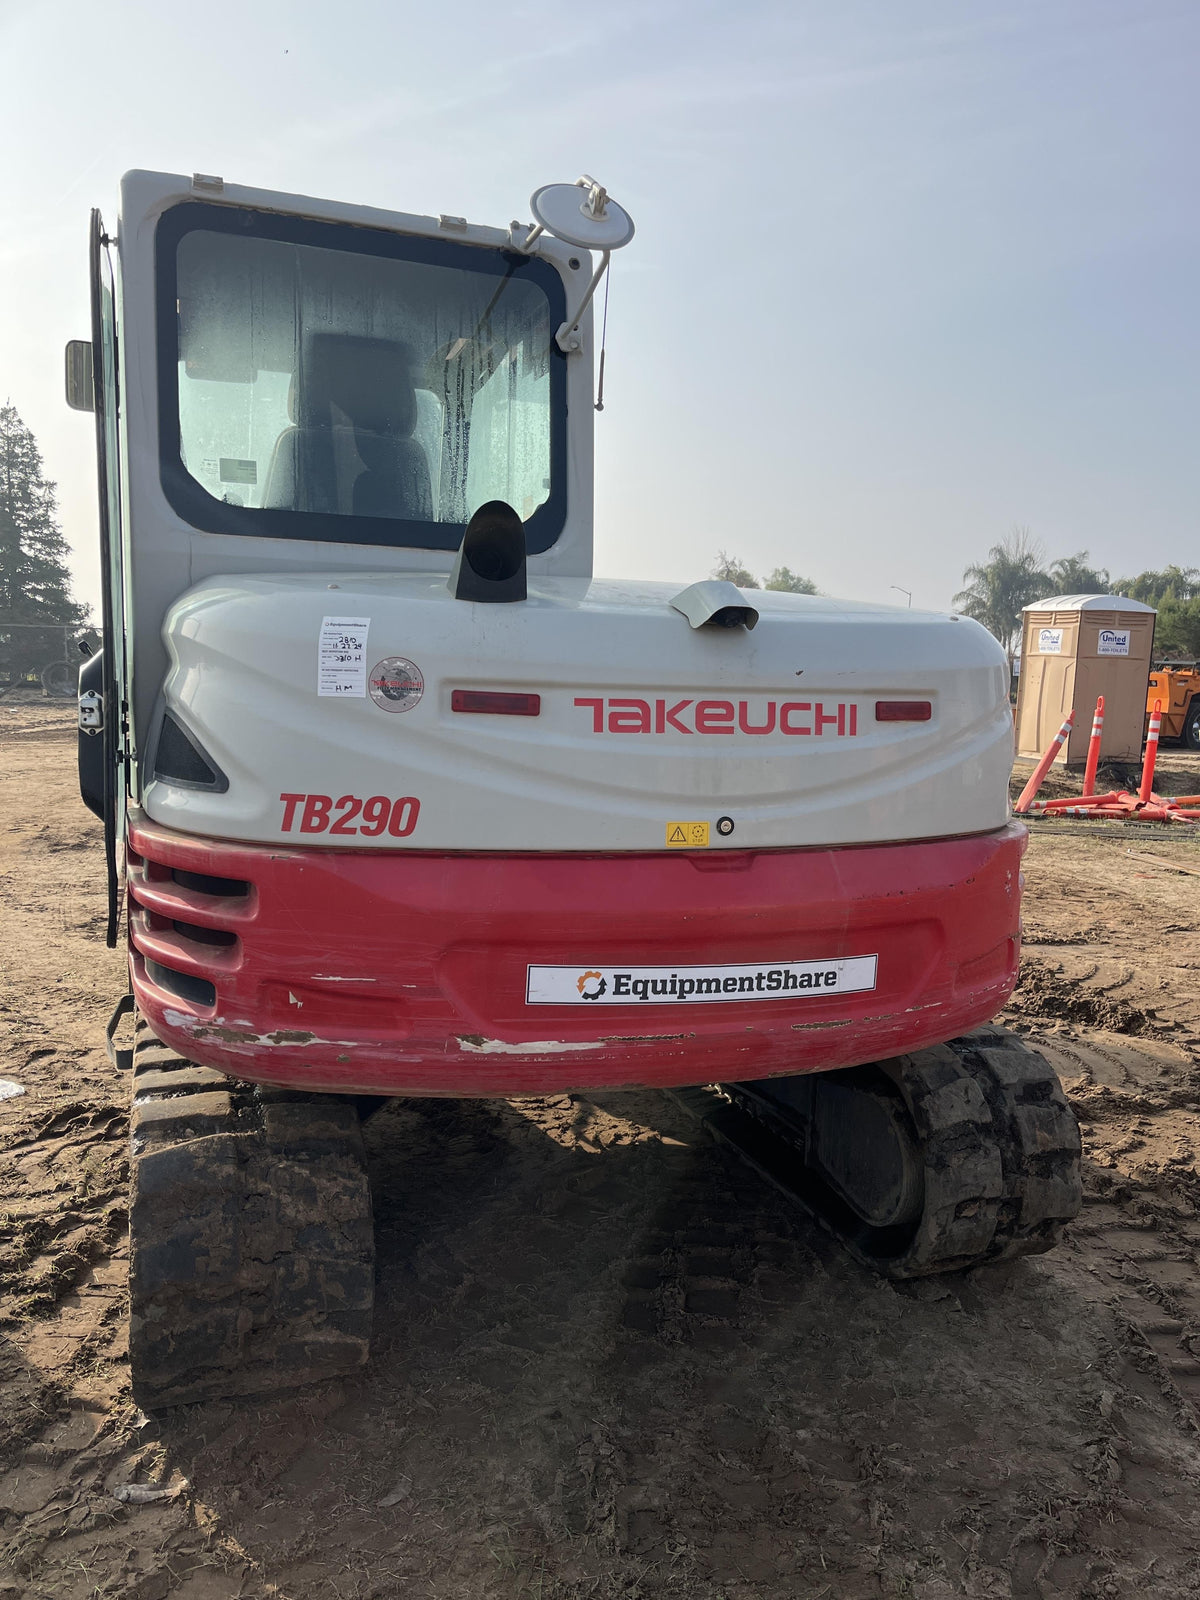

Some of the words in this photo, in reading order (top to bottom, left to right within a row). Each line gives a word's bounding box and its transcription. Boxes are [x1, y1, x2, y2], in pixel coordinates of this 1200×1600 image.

[1102, 634, 1126, 642] United
[280, 793, 420, 837] TB290
[612, 968, 837, 1000] EquipmentShare
